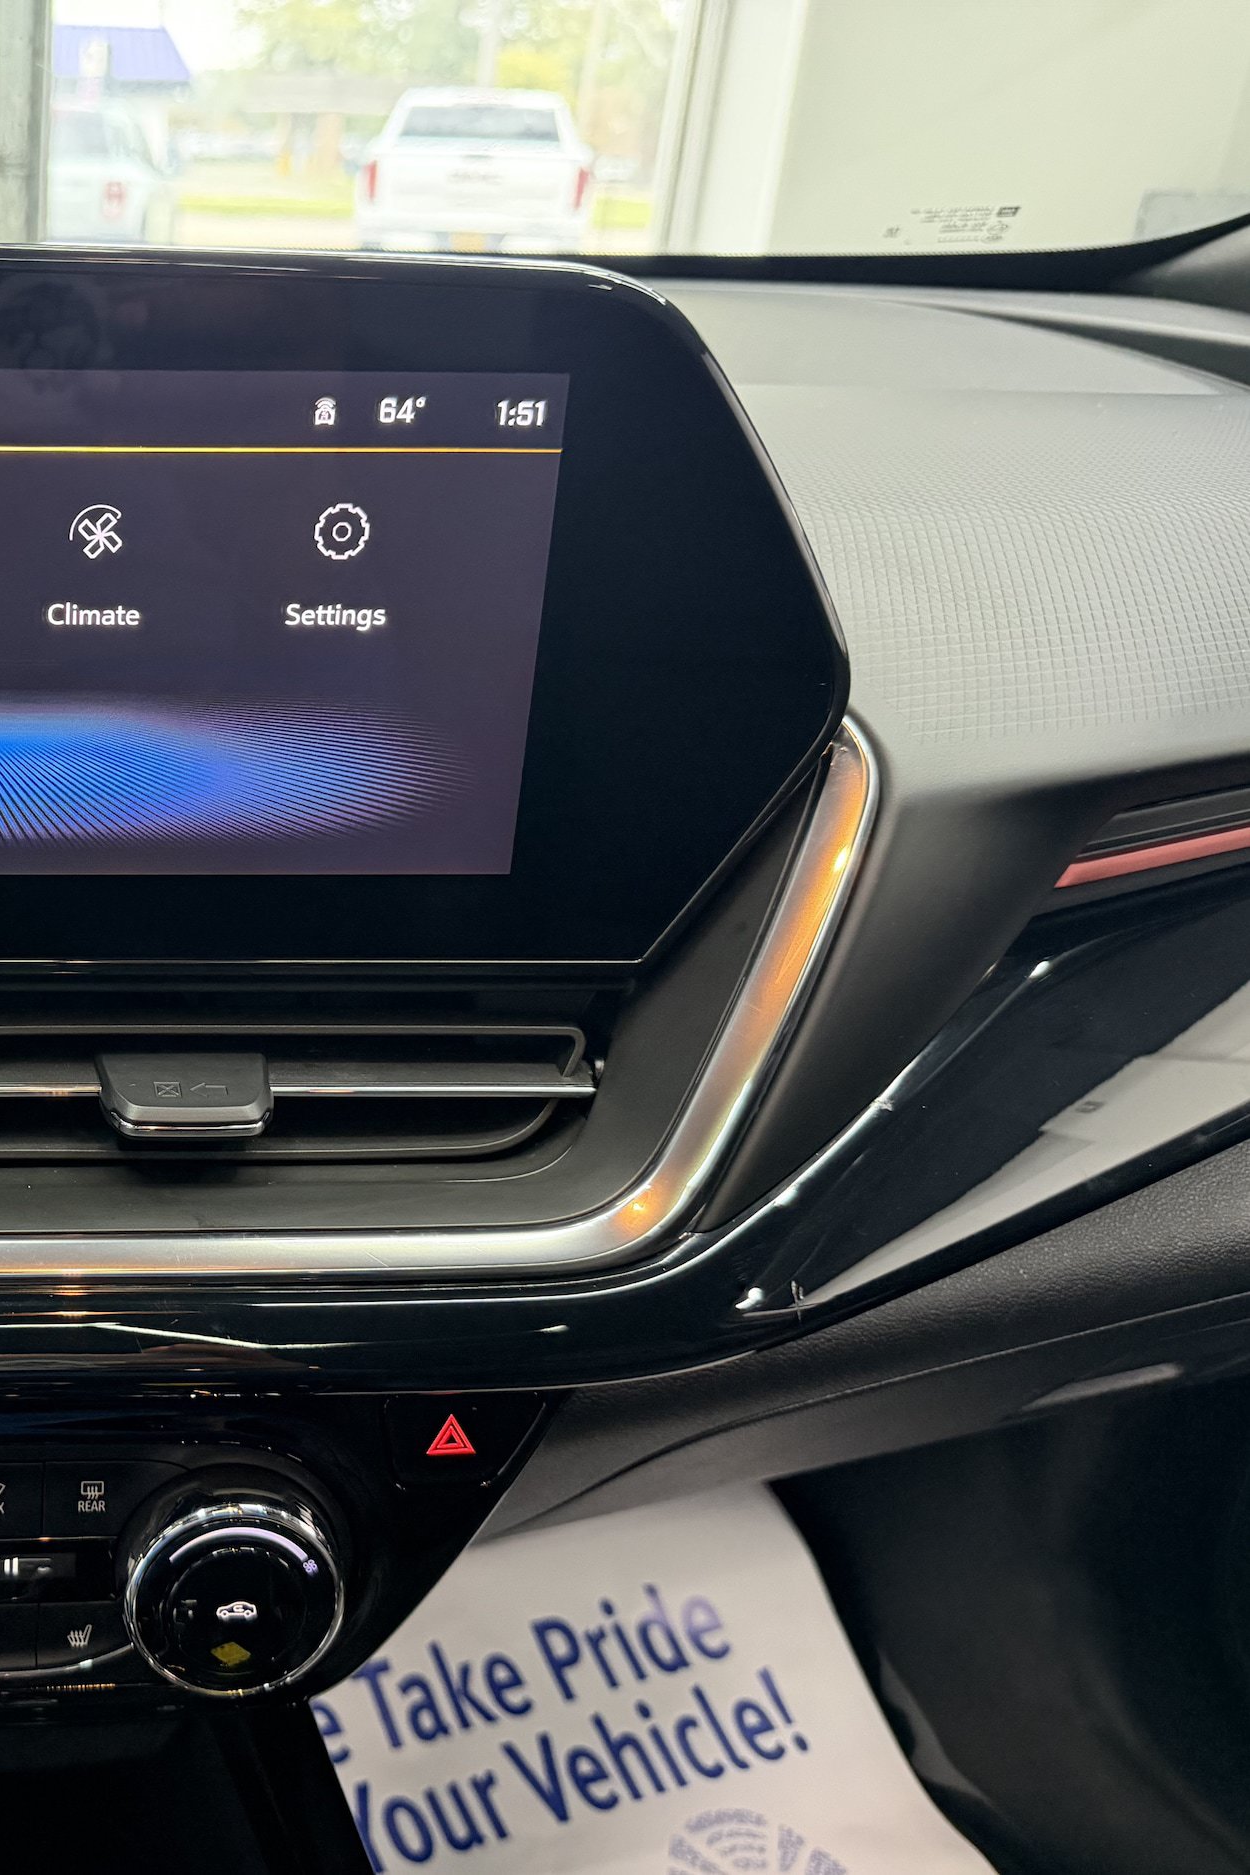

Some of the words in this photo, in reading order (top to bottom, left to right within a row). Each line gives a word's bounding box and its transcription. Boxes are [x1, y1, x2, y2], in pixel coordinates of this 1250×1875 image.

[379, 396, 426, 424] 64°
[497, 400, 547, 427] 1:51
[47, 603, 140, 627] Climate
[284, 603, 386, 631] Settings
[77, 1499, 106, 1513] REAR
[351, 1641, 534, 1749] Take
[530, 1582, 733, 1702] Pride
[503, 1667, 810, 1824] Vehicle!
